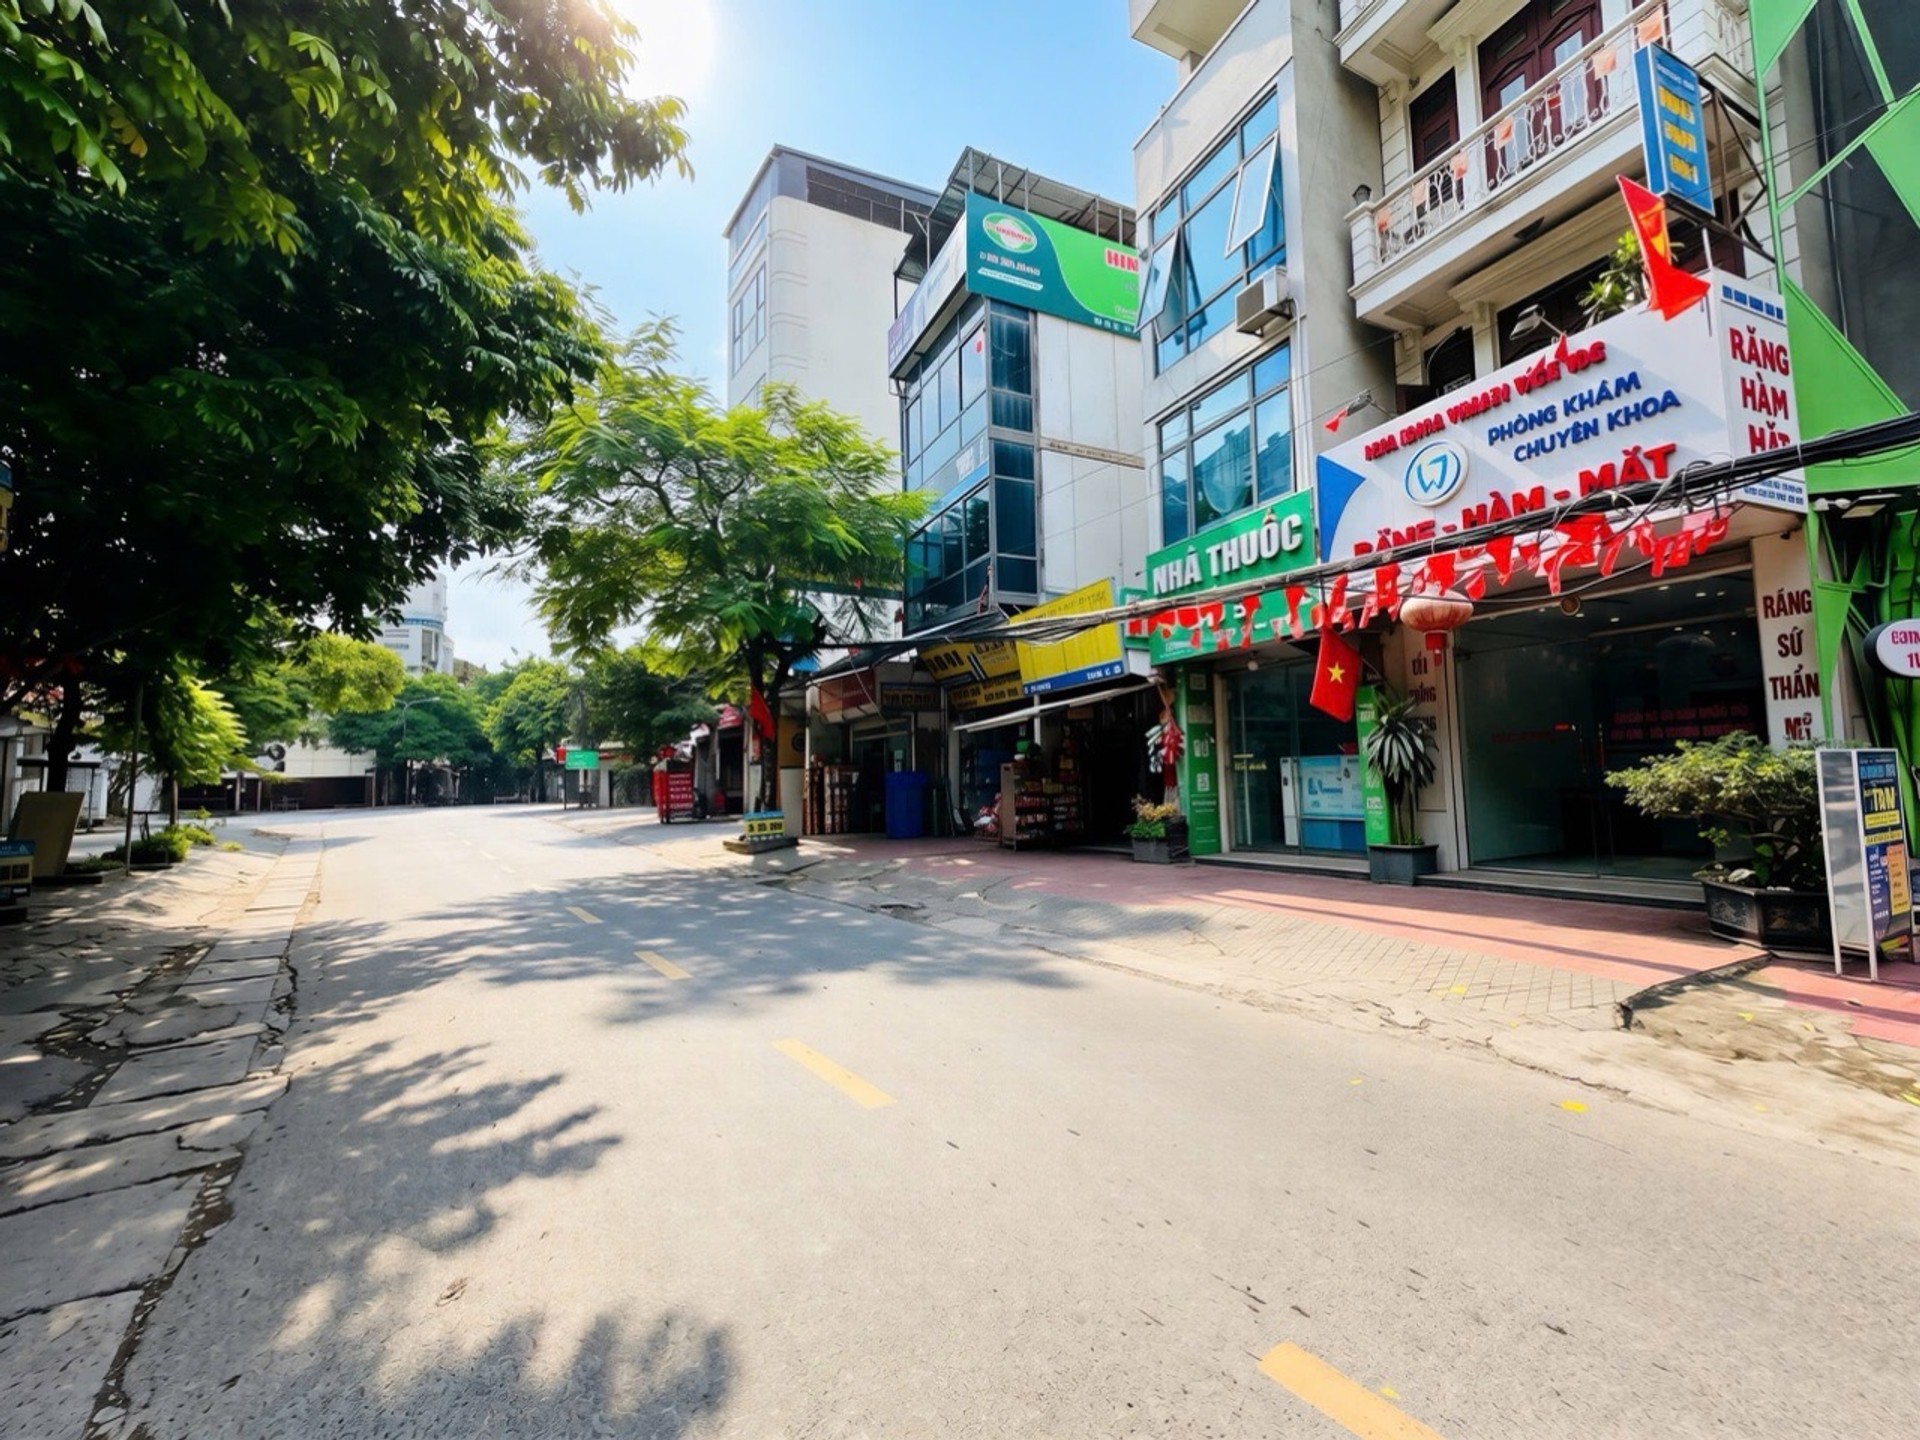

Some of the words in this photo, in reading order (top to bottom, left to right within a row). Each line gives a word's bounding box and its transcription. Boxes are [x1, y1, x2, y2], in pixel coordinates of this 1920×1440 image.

[1729, 325, 1790, 376] RĂNG
[1740, 372, 1789, 421] HÀM
[1488, 405, 1557, 446] PHÒNG
[1514, 417, 1600, 463] CHUYÊN
[1607, 389, 1682, 432] KHOA
